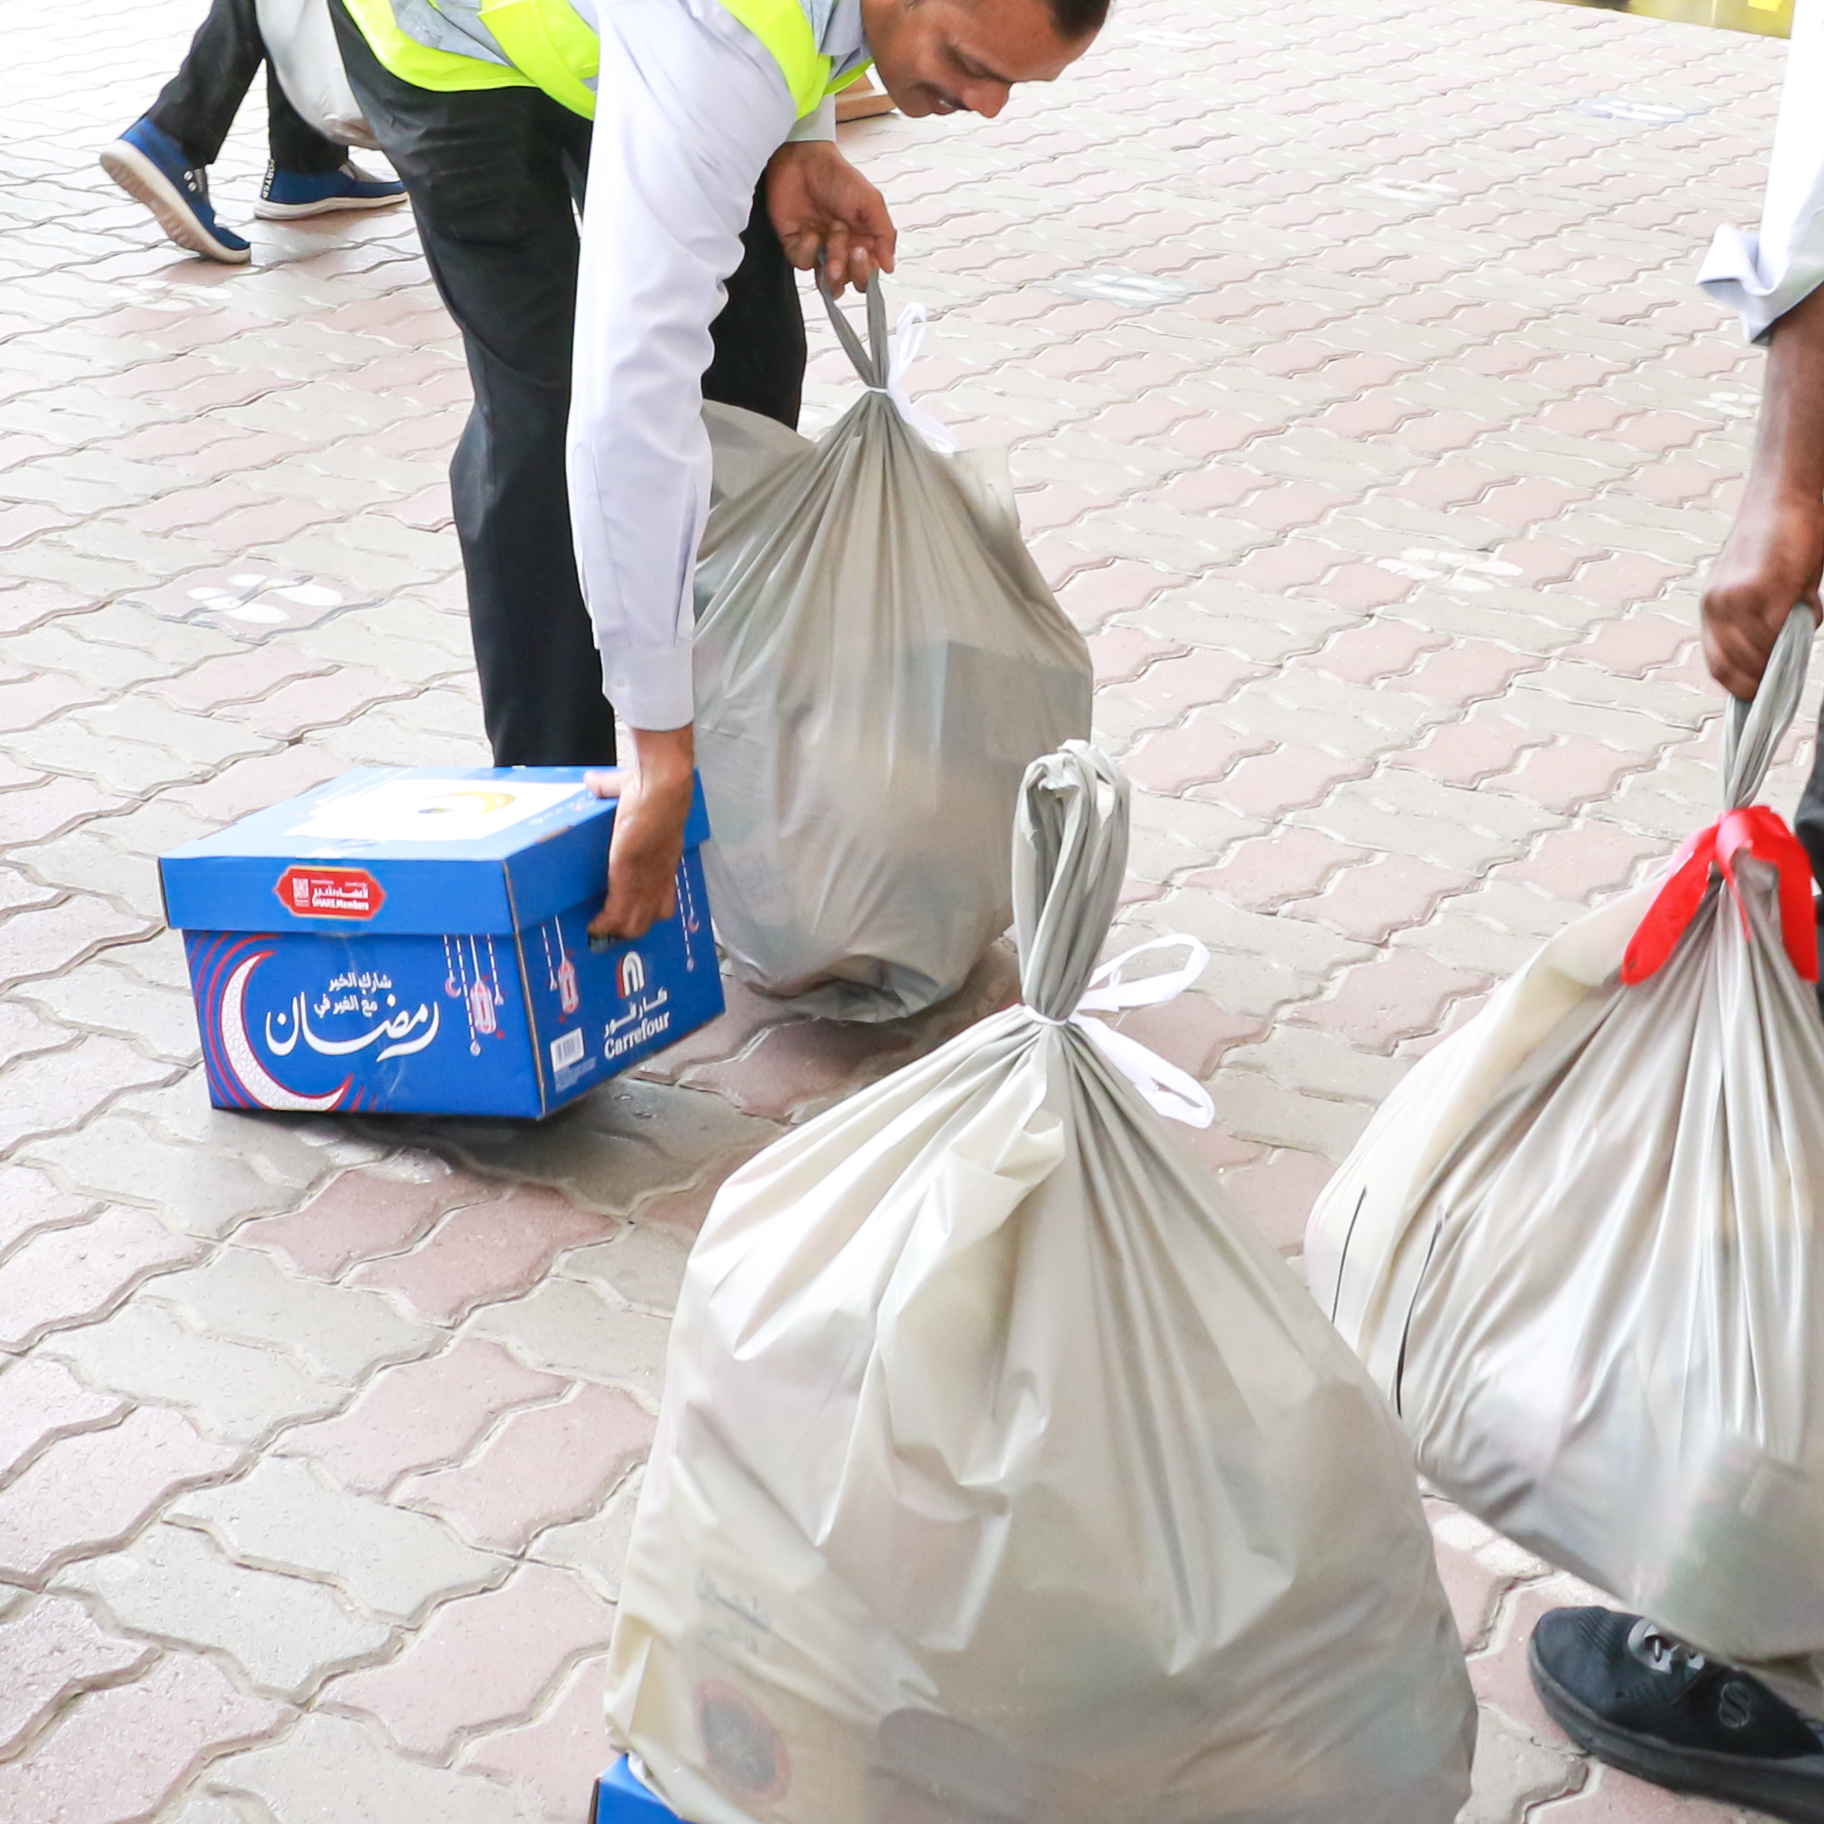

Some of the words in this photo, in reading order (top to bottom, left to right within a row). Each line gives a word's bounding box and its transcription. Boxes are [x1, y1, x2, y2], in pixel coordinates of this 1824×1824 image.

[328, 971, 358, 993] الخير
[359, 971, 393, 996] شارك
[313, 993, 331, 1019] في
[333, 994, 360, 1016] الغير
[361, 997, 379, 1018] مع
[604, 986, 669, 1039] كارفور
[264, 991, 440, 1063] رمضان
[604, 1011, 670, 1060] Carrefour
